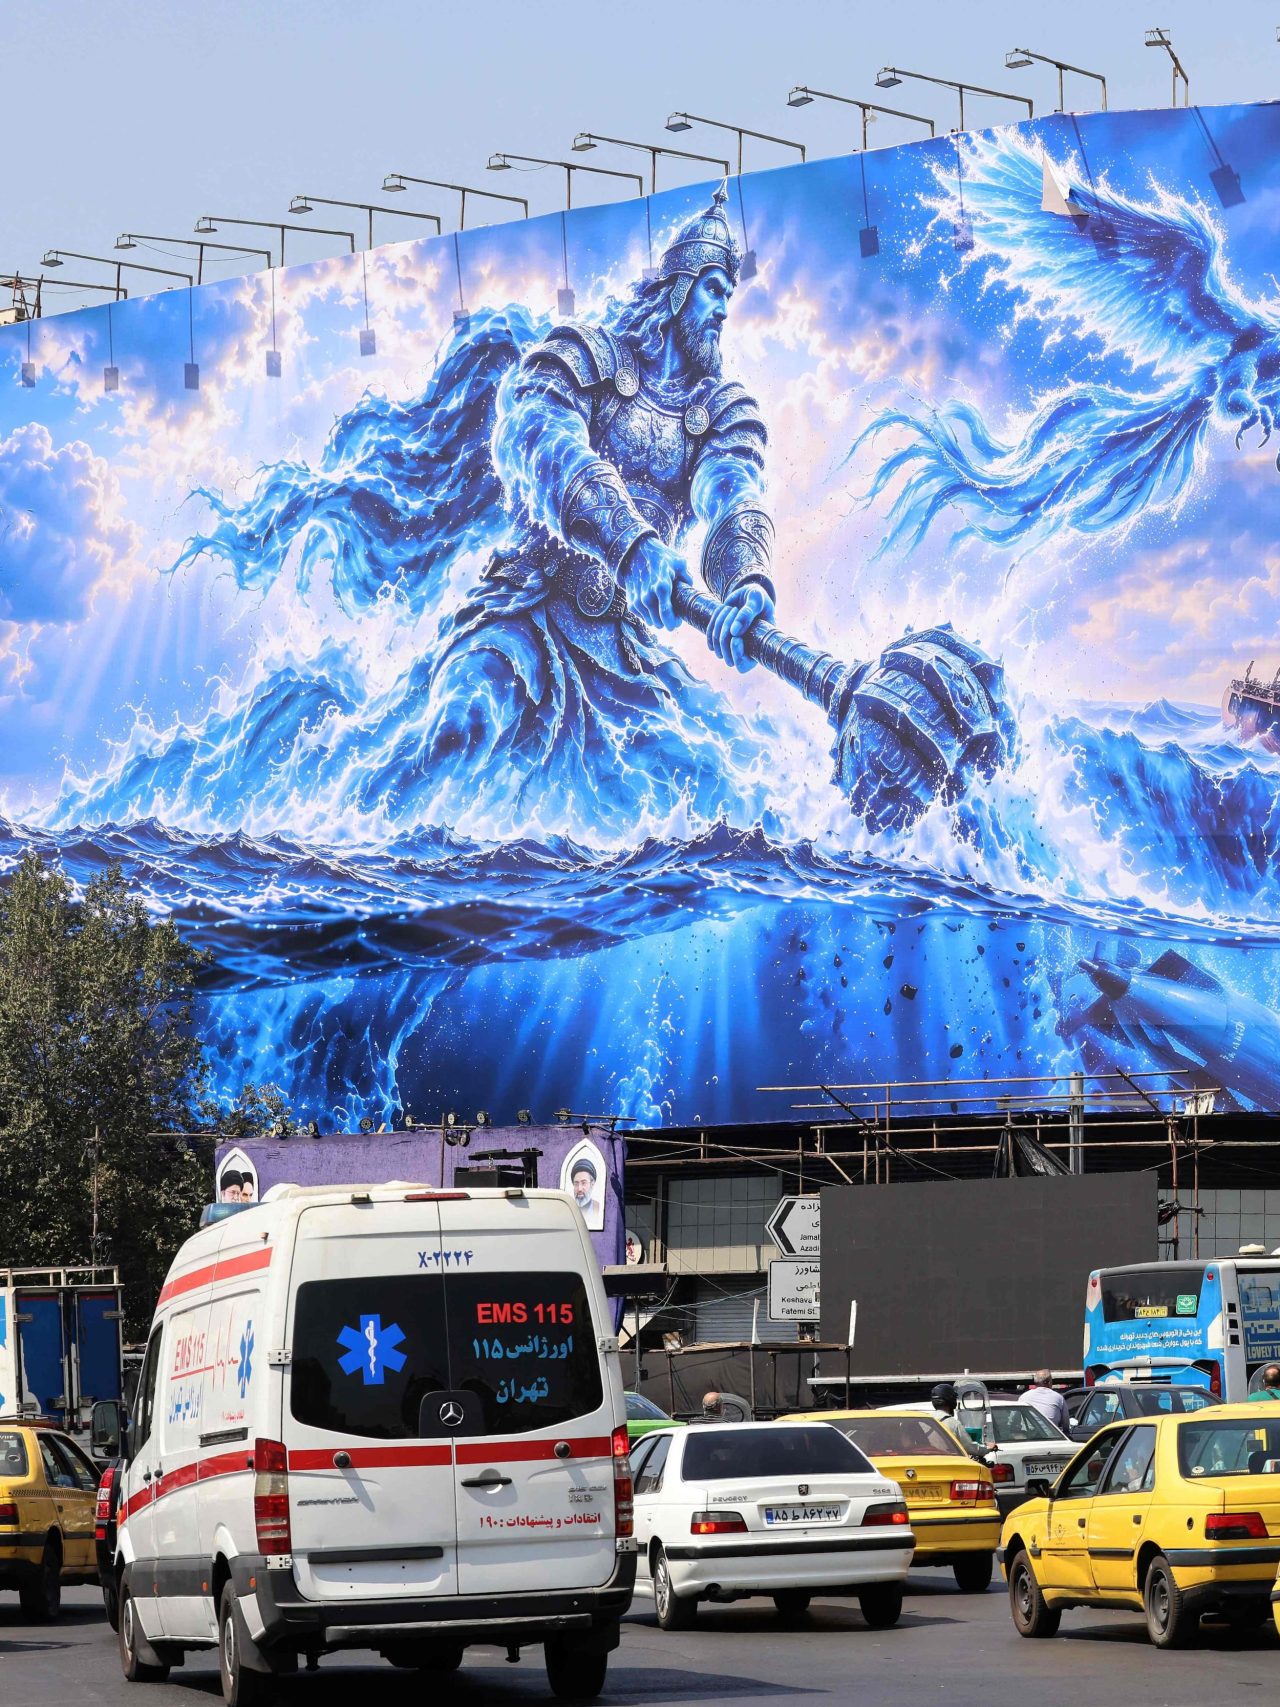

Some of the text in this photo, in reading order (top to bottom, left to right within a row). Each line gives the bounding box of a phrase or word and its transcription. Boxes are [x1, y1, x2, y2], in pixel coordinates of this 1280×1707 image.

[781, 1296, 813, 1304] Keshava
[476, 1303, 574, 1324] EMS 115
[174, 1332, 206, 1372] EMS 115
[473, 1335, 574, 1359] اورژانس ۱۱۵
[1248, 1345, 1272, 1359] LOVELY
[495, 1376, 549, 1404] تهران
[556, 1518, 562, 1529] و
[563, 1512, 601, 1525] انتقادات
